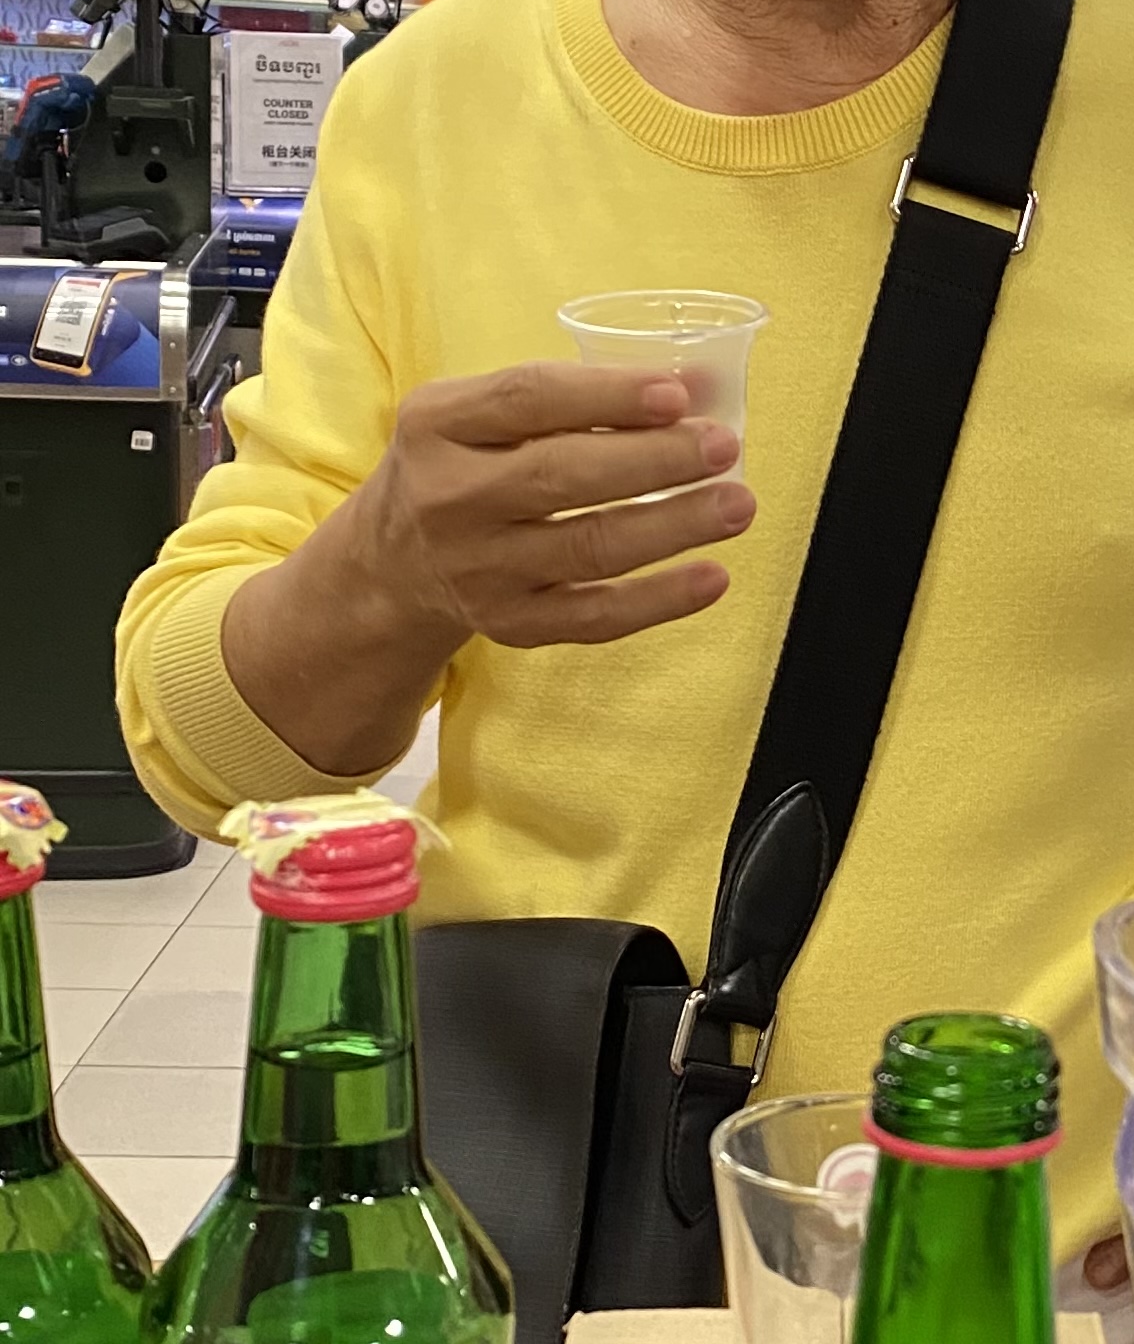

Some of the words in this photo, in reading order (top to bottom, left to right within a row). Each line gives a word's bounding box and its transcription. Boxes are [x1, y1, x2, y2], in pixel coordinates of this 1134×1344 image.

[263, 98, 314, 109] COUNTER
[267, 109, 309, 119] CLOSED
[261, 144, 317, 160] 柜台关闭
